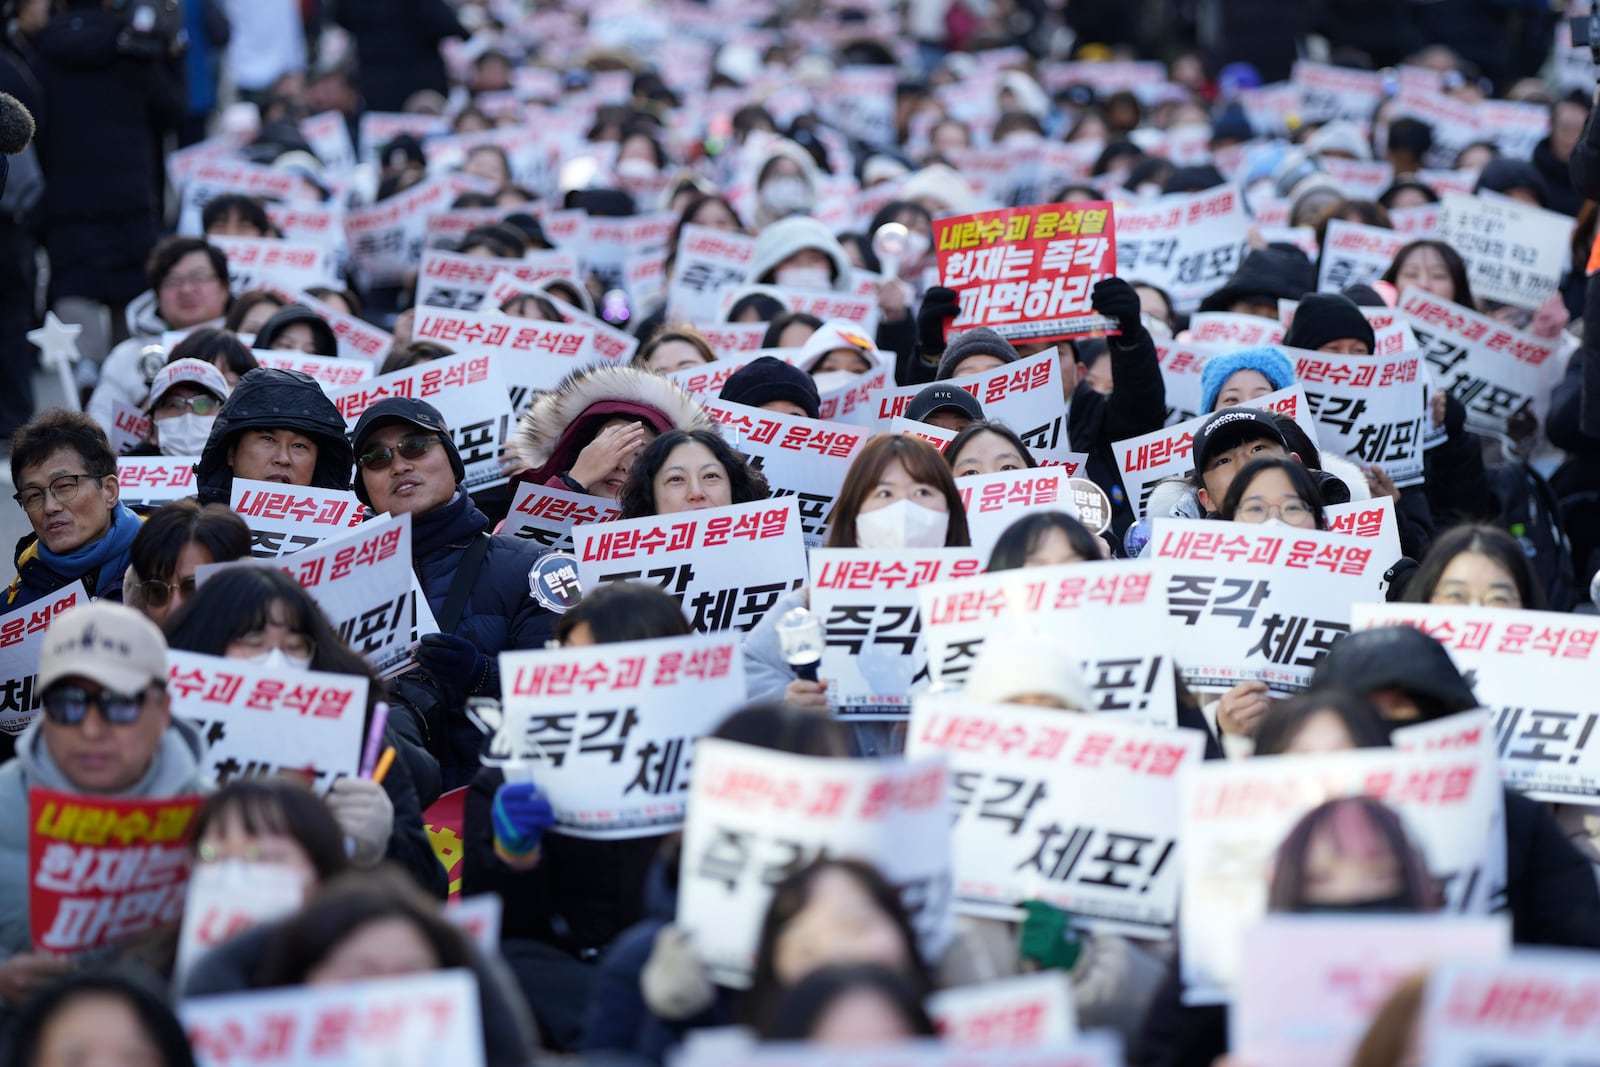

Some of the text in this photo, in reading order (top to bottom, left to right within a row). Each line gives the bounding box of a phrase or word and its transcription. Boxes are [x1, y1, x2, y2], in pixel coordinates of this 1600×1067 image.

[939, 209, 1109, 251] 내란수괴 윤석열
[944, 237, 1109, 287] 헌재는 즉각
[952, 273, 1114, 327] 파면하라
[418, 316, 585, 356] 내란수괴 윤석열
[1402, 295, 1552, 369] 내란수괴 윤석열
[420, 356, 490, 398] 윤석열
[934, 391, 952, 399] NYC
[985, 358, 1052, 405] 윤석열
[1379, 359, 1418, 388] 윤석열
[450, 414, 509, 465] 포!
[779, 426, 860, 458] 윤석열
[1125, 432, 1194, 474] 내란수
[1346, 417, 1422, 463] 체포!
[235, 490, 349, 526] 내란수괴
[768, 488, 834, 535] 포!
[979, 476, 1060, 513] 윤석열
[1073, 489, 1102, 508] 란범
[582, 521, 697, 562] 내란수괴
[703, 507, 789, 548] 윤석열
[1330, 507, 1384, 538] 석열
[330, 526, 403, 581] 윤석열
[543, 564, 577, 589] 탄핵
[817, 560, 942, 590] 내란수괴
[1159, 531, 1372, 577] 내란수괴 윤석열
[598, 563, 695, 601] 각
[1054, 572, 1153, 611] 윤석열
[1166, 574, 1271, 629] 즉각
[0, 592, 77, 648] 윤석열
[824, 605, 921, 656] 즉각
[1246, 613, 1350, 667] 체포
[1496, 623, 1599, 660] 윤석열
[513, 645, 733, 697] 내란수괴 윤석열
[941, 639, 985, 685] 즉
[1083, 655, 1163, 711] 포!
[0, 674, 41, 713] 체
[245, 677, 354, 720] 윤석열
[523, 707, 640, 767] 즉각
[920, 712, 1188, 778] 내란수괴 윤석열
[623, 735, 696, 796] 체
[36, 801, 195, 846] 내란수괴
[35, 843, 190, 895] 헌재는
[1016, 820, 1177, 895] 체포!
[42, 885, 184, 949] 파면
